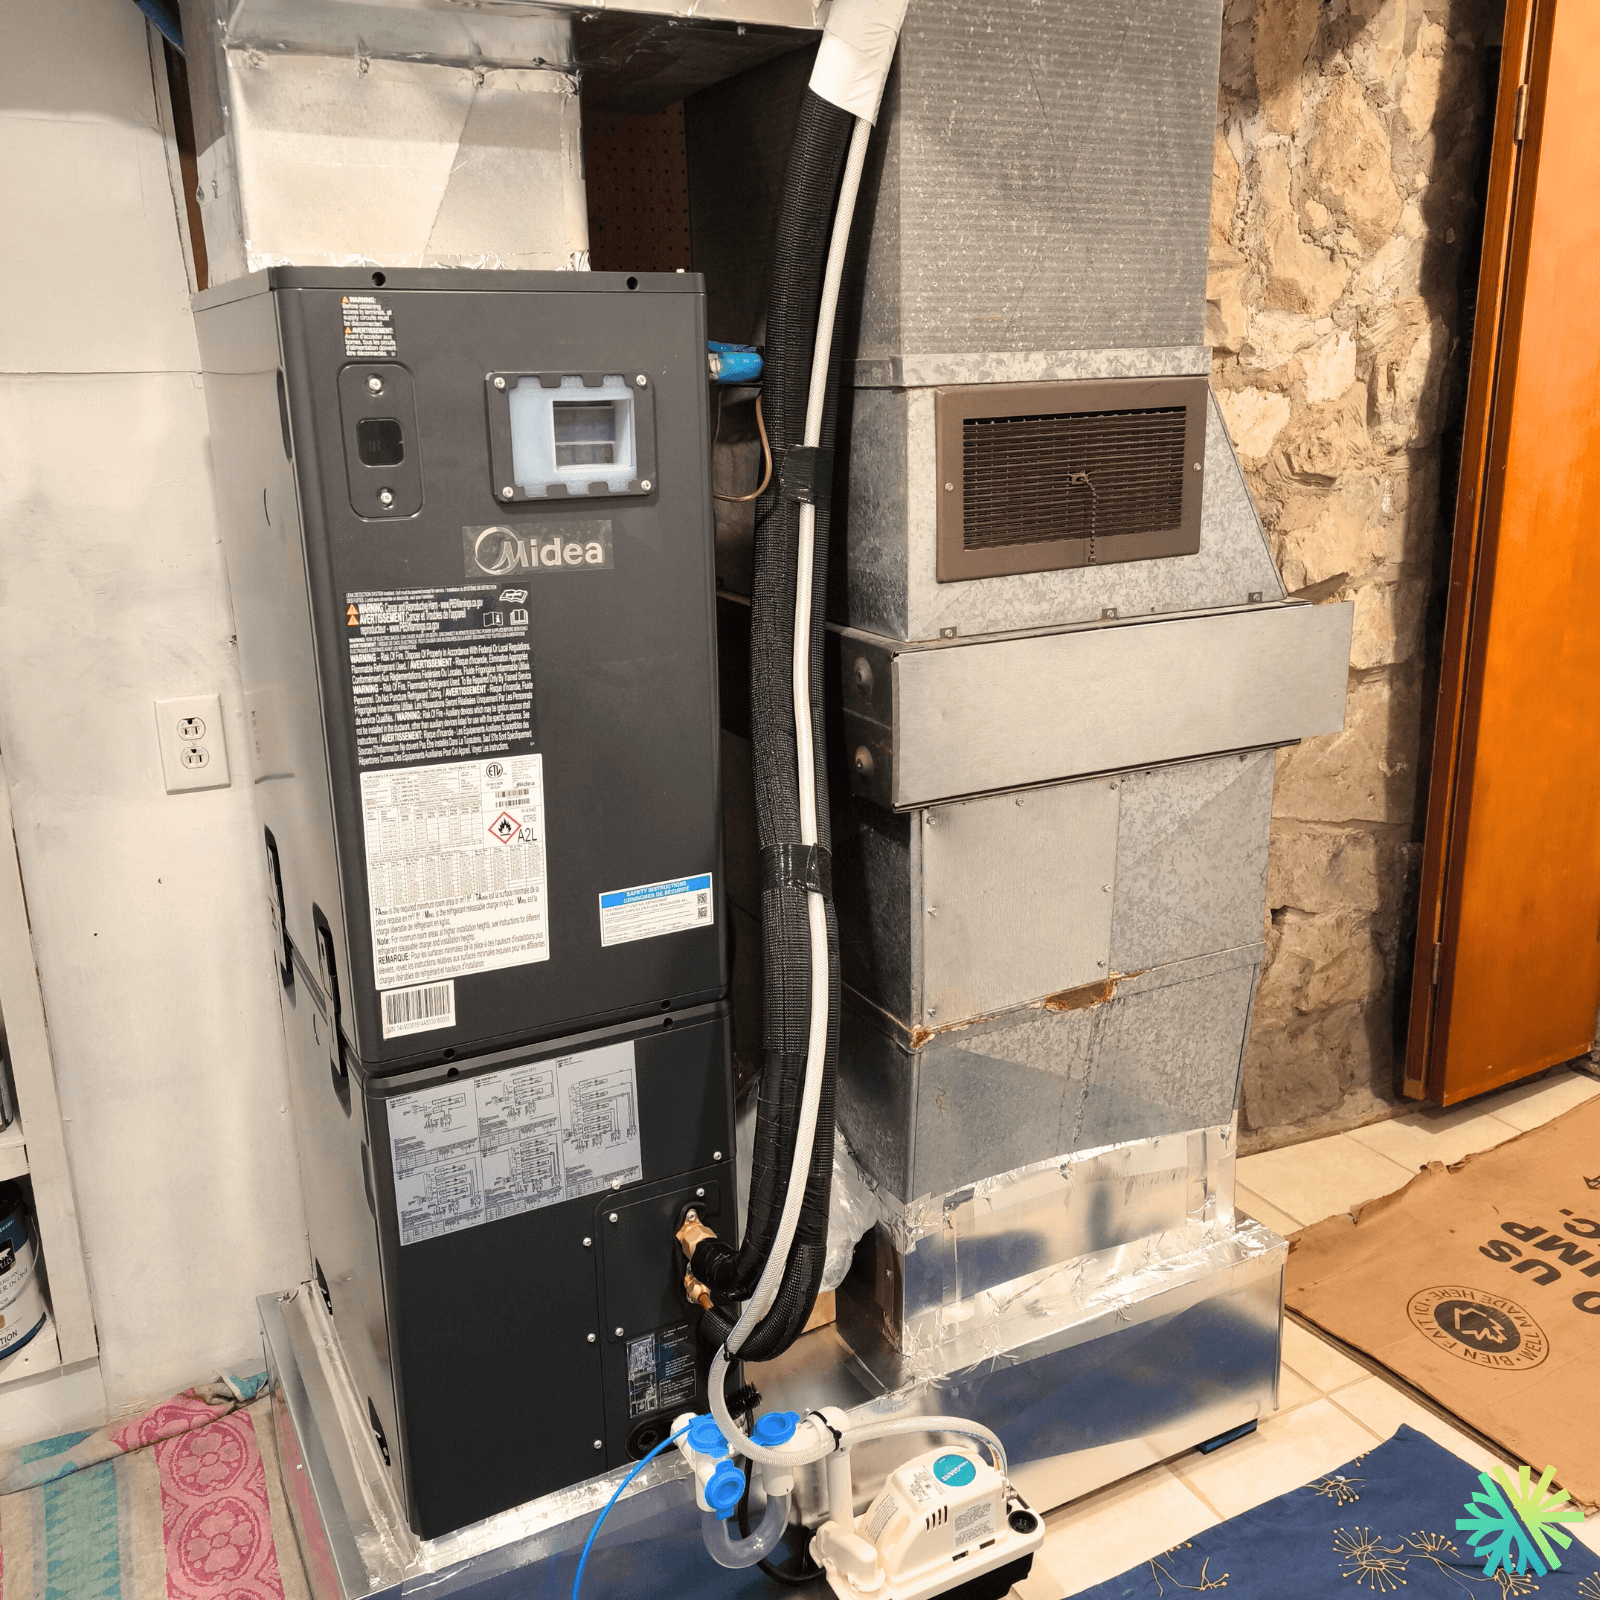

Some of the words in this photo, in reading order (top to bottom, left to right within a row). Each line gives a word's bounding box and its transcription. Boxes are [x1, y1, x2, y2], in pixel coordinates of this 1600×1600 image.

[350, 653, 376, 663] WARNING
[352, 684, 378, 694] WARNING
[517, 827, 537, 842] A2L
[376, 936, 390, 946] Note:
[378, 953, 410, 966] REMARQUE:
[1478, 1239, 1562, 1286] US
[1428, 1289, 1475, 1300] HERE
[1414, 1302, 1430, 1316] ICI
[1481, 1295, 1532, 1328] MADE
[0, 1330, 17, 1345] TION
[1417, 1318, 1457, 1349] FAIT
[1519, 1332, 1542, 1361] WELL
[1464, 1348, 1515, 1366] BIEN
